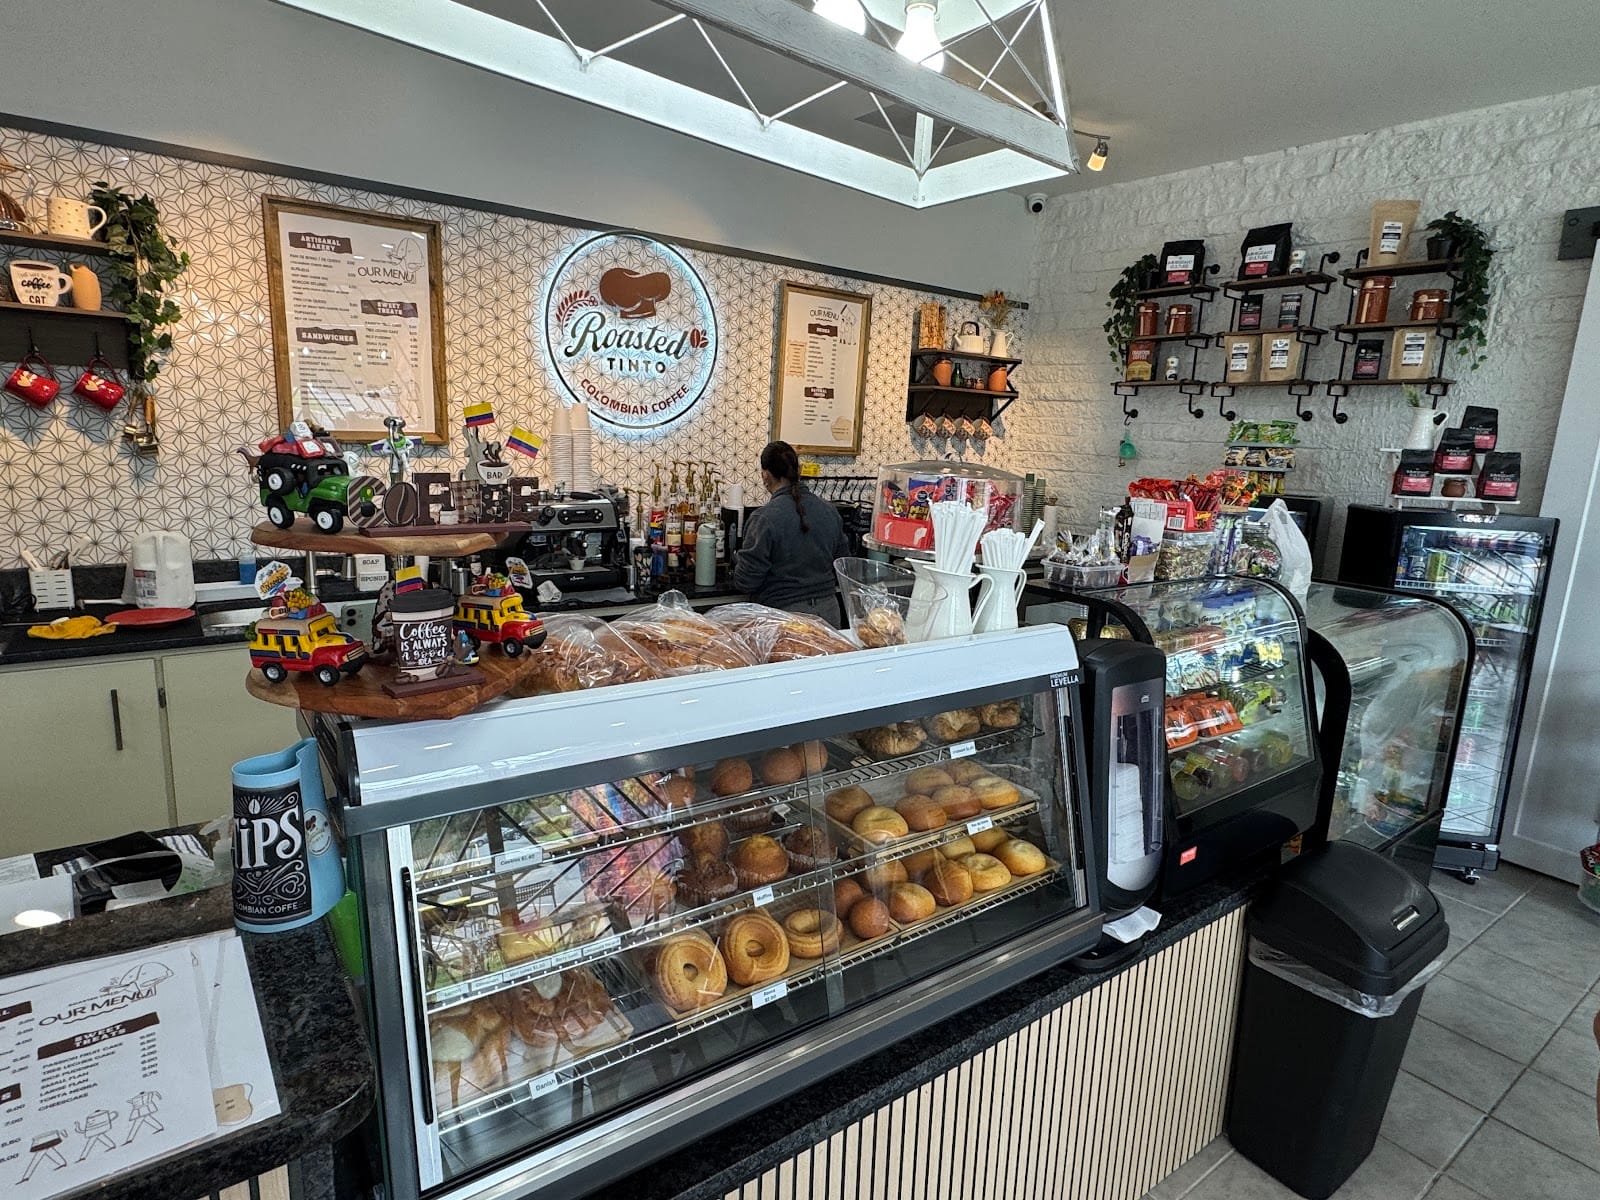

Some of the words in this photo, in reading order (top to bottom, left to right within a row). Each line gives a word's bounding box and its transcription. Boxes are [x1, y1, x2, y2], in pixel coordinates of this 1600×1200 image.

[358, 266, 381, 278] OUR
[21, 277, 52, 290] coffee
[29, 295, 46, 304] CAT
[302, 332, 354, 342] SANDWICHES
[564, 311, 689, 360] Roasted
[607, 357, 666, 374] TINTO
[580, 379, 648, 415] COLOMBIAN
[651, 384, 690, 413] COFFEE
[400, 622, 448, 640] Coffee
[401, 641, 410, 652] IS
[413, 637, 448, 650] ALWAYS
[1050, 674, 1079, 688] LEVELLA
[39, 1006, 87, 1026] OUR
[74, 1024, 123, 1044] SWEET
[75, 1027, 127, 1048] TREATS
[42, 1055, 78, 1069] PASSION
[79, 1048, 101, 1058] FRUIT
[102, 1042, 123, 1051] CAKE
[94, 1050, 116, 1060] CAKE
[40, 1078, 67, 1090] SMALL
[68, 1071, 89, 1081] FLAN
[41, 1073, 60, 1083] RICE
[62, 1062, 100, 1076] PUDDING
[39, 1085, 67, 1097] LARGE
[68, 1078, 89, 1088] FLAN
[535, 1079, 556, 1091] Danish
[39, 1092, 67, 1104] TORTA
